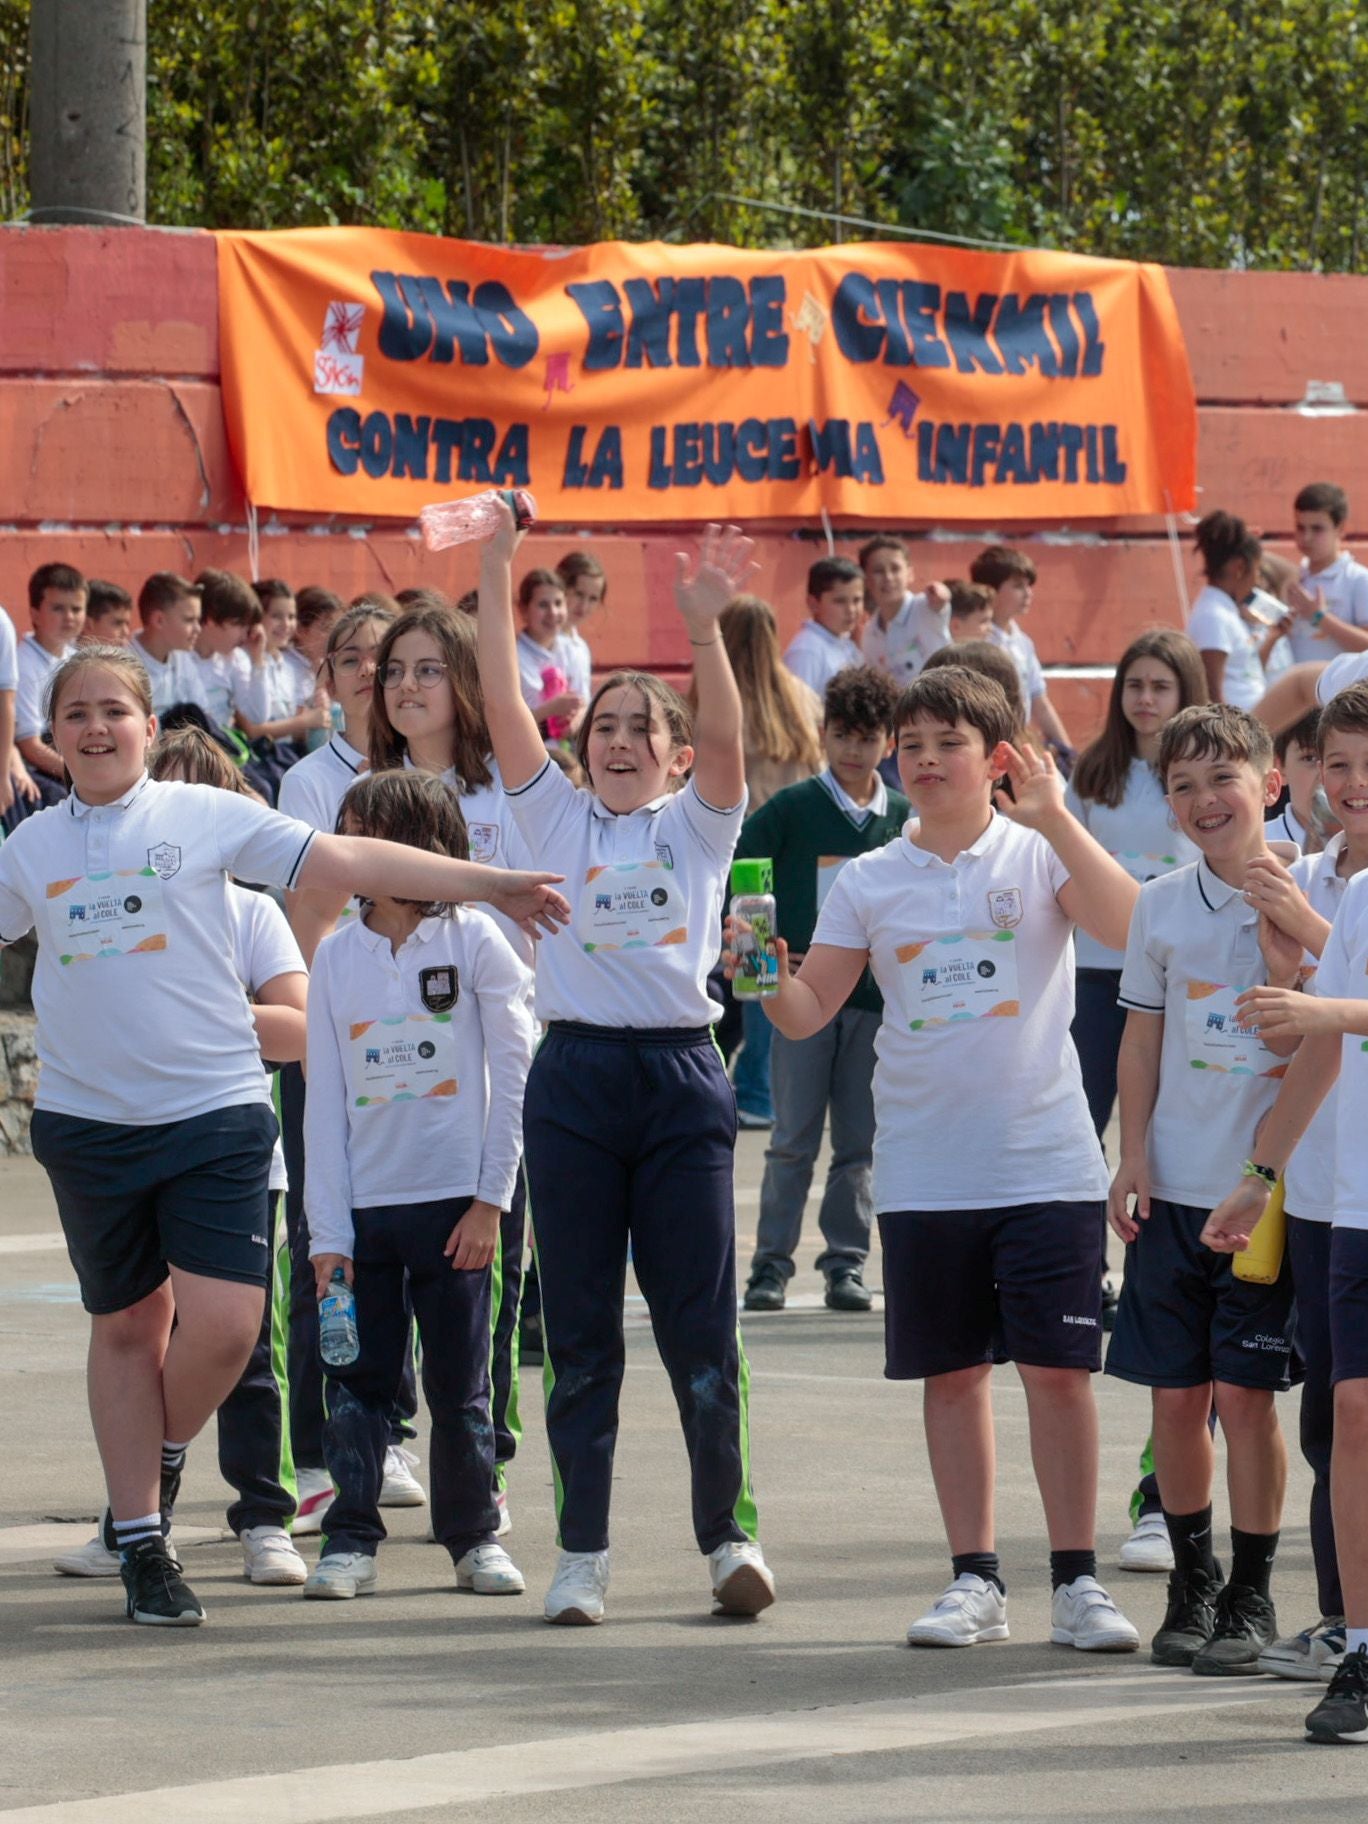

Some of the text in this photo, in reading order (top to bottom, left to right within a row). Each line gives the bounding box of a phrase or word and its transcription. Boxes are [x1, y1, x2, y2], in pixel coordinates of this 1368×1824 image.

[370, 270, 539, 369] UNO
[565, 274, 789, 370] ENTRE
[327, 407, 530, 485] CONTRA
[561, 425, 623, 490] LA
[917, 420, 1127, 488] INFANTIL
